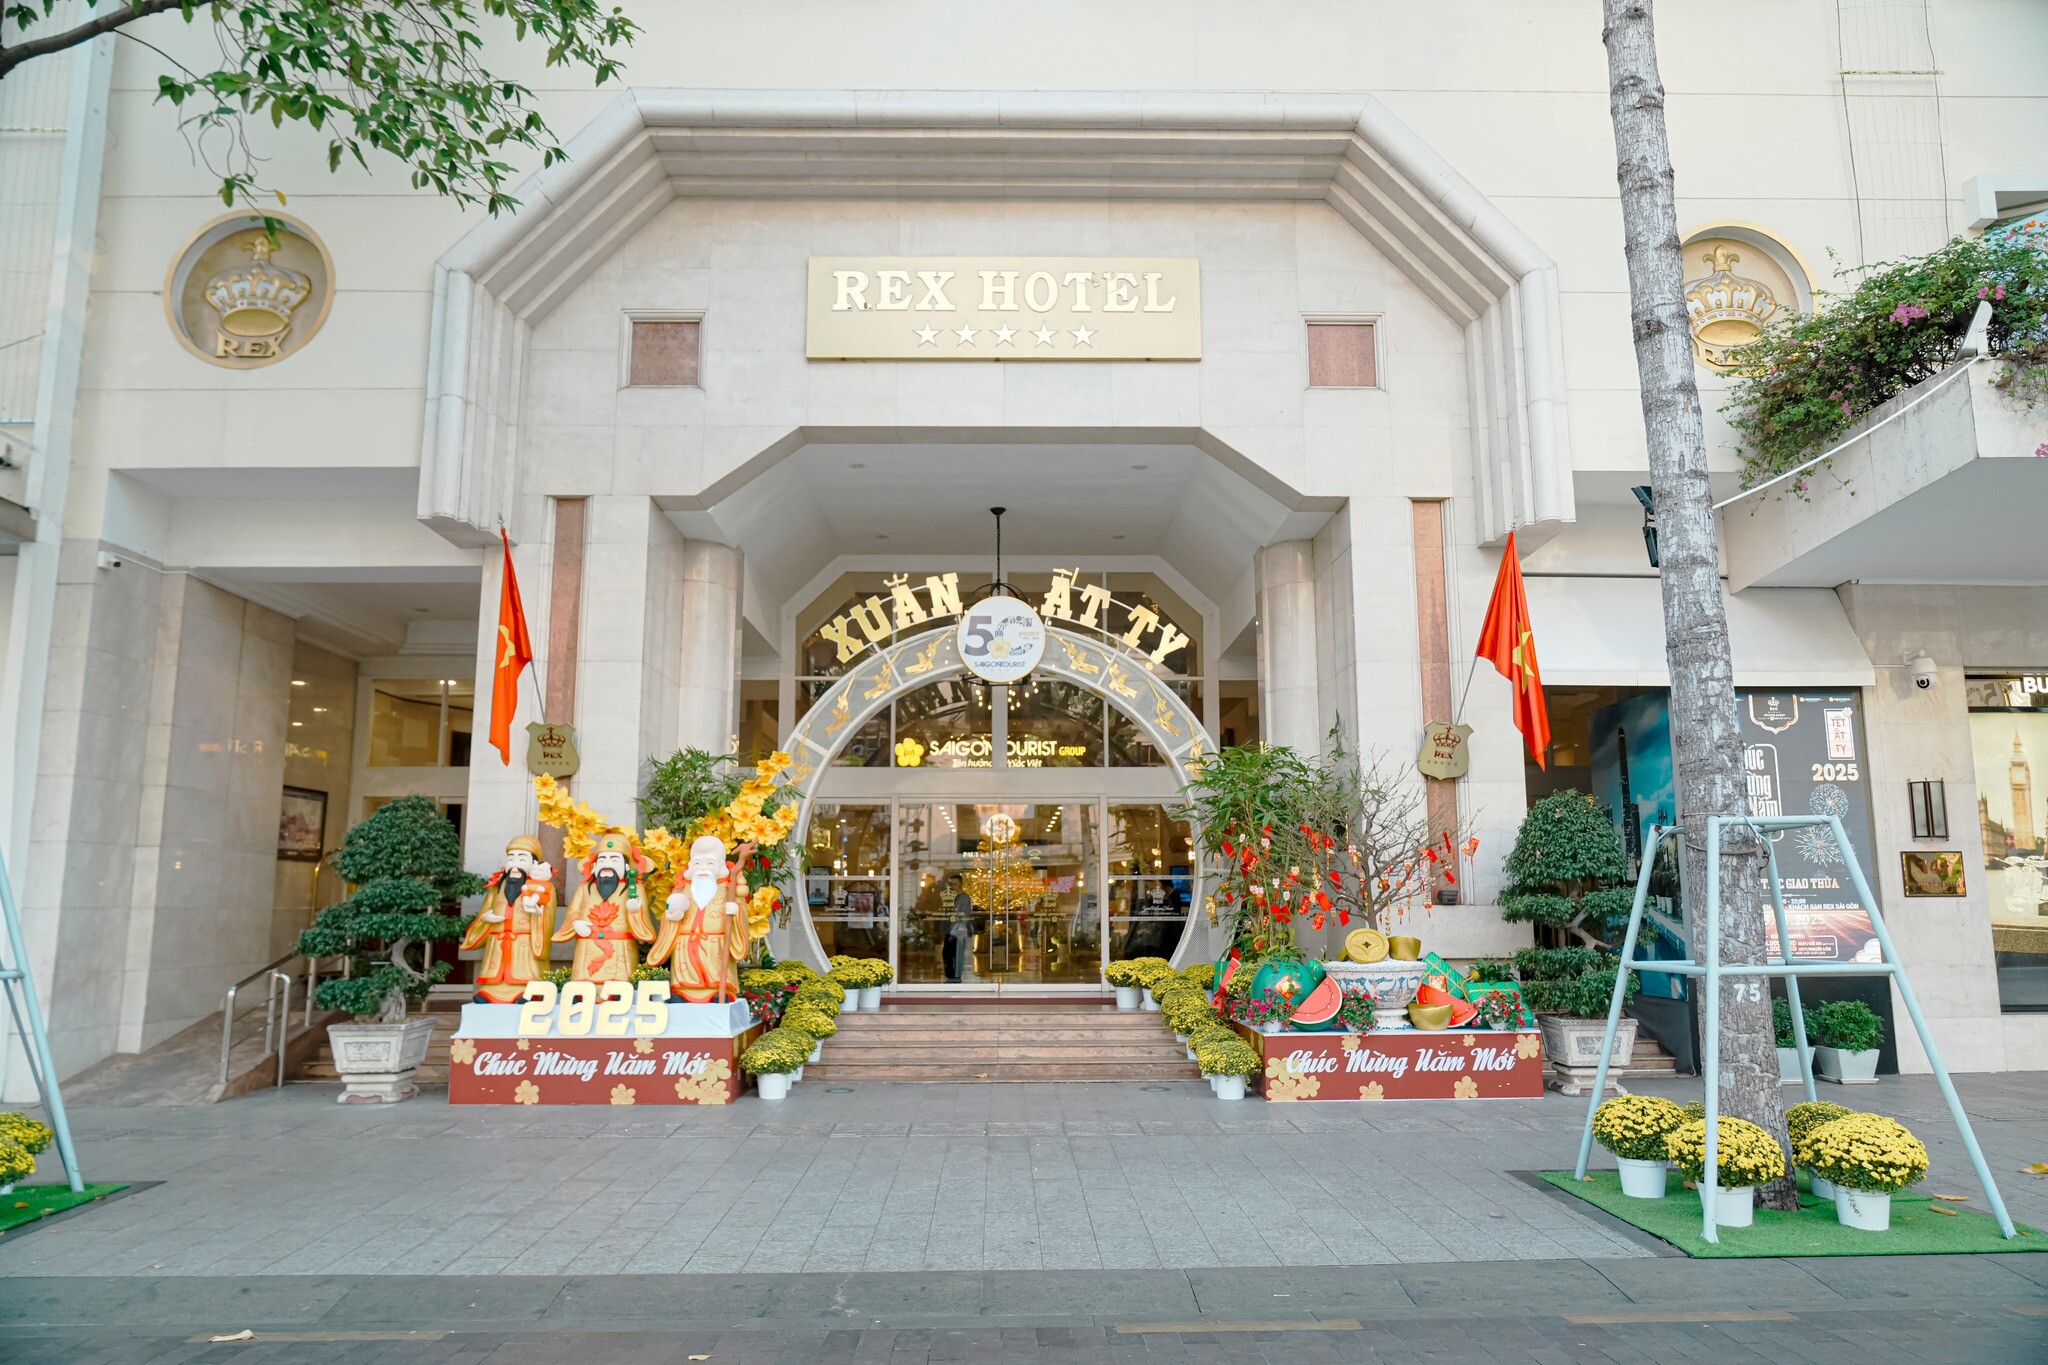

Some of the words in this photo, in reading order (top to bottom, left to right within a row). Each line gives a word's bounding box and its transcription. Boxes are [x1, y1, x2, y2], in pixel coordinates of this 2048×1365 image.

[832, 270, 957, 312] REX
[977, 270, 1177, 313] HOTEL
[215, 328, 292, 358] REX
[1041, 566, 1111, 628] ẤT
[929, 740, 1057, 756] SAIGONOURIST
[1059, 746, 1086, 756] GROUP
[1434, 751, 1453, 759] REX
[1811, 763, 1859, 781] 2025
[1786, 878, 1809, 889] GIAO
[517, 981, 671, 1036] 2025
[1733, 983, 1761, 1004] 75
[473, 1051, 528, 1076] Chúc
[532, 1051, 598, 1082] Mừng
[603, 1051, 657, 1076] Năm
[662, 1051, 711, 1076] Mới
[1286, 1049, 1339, 1074] Chúc
[1344, 1048, 1409, 1079] Mừng
[1414, 1048, 1466, 1072] Năm
[1470, 1047, 1517, 1072] Mới
